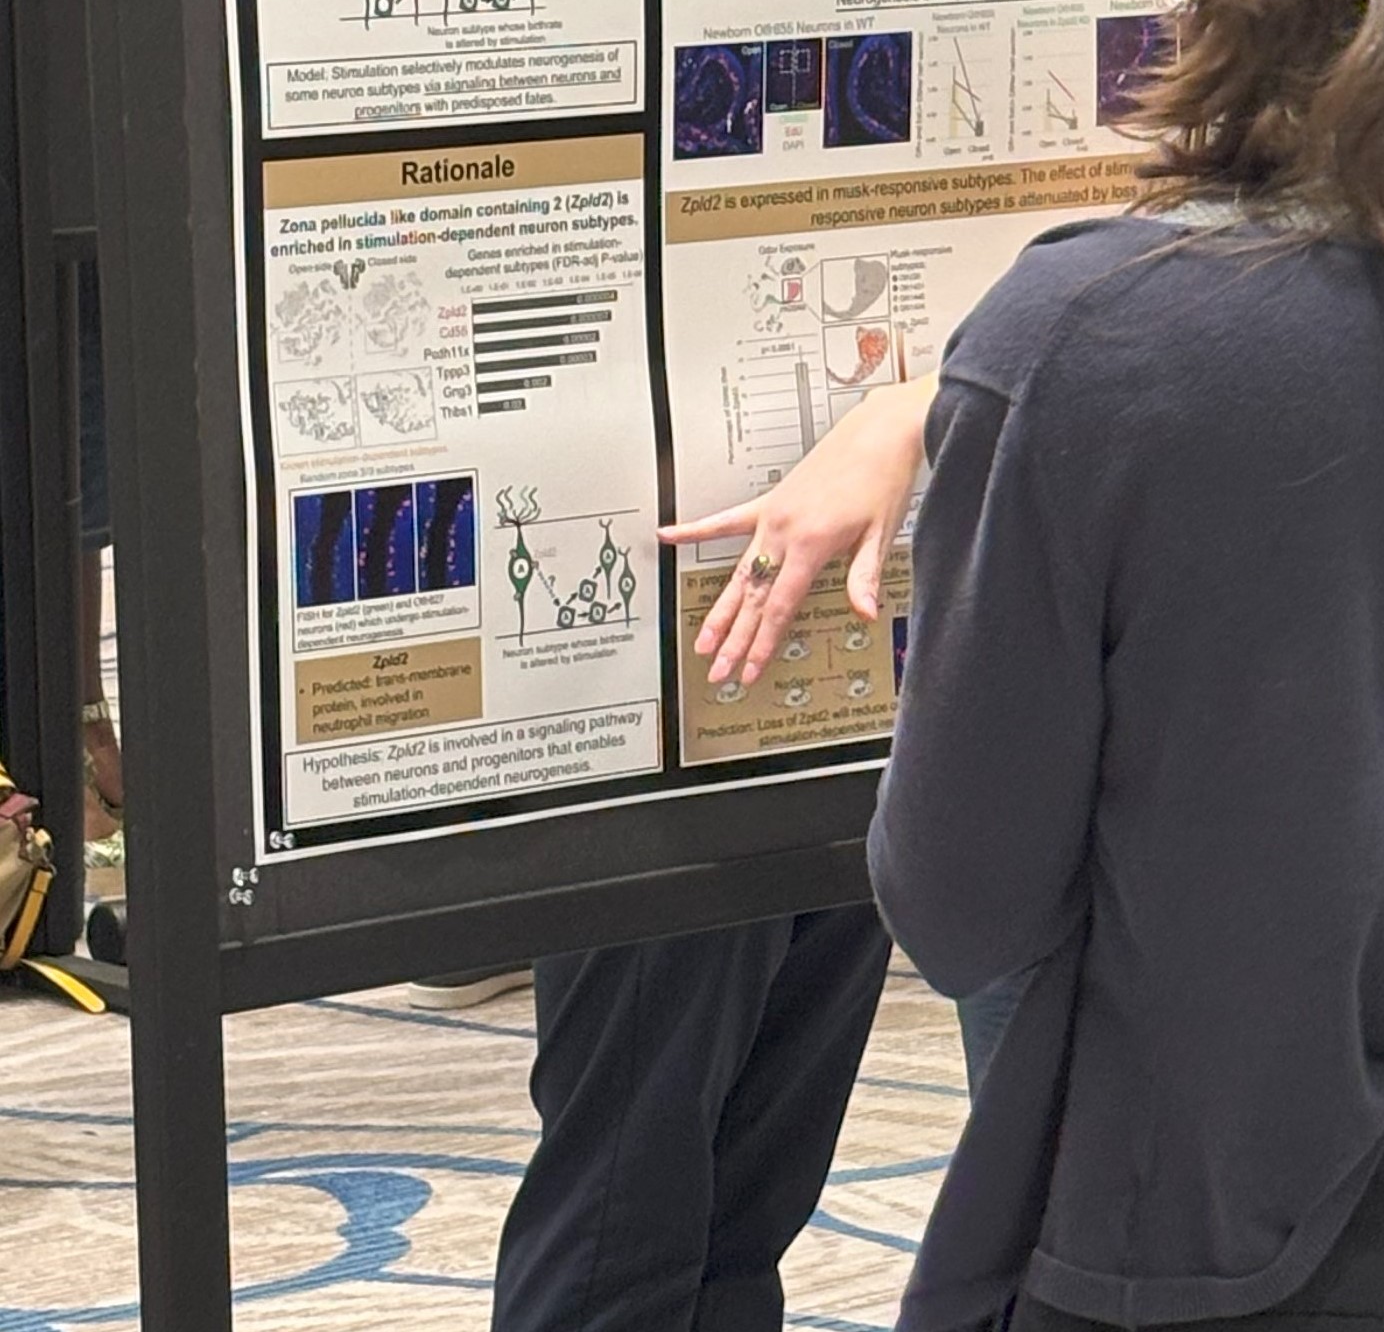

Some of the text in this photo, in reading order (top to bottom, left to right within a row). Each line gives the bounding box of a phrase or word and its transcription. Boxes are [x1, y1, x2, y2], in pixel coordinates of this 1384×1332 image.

[401, 154, 515, 186] Rationale
[279, 190, 630, 235] Zona pellucida like domain containing 2 (Zpld2) is
[269, 214, 639, 258] enriched in stimulation-dependent neuron subtypes.
[386, 740, 426, 763] Zpld2
[428, 739, 441, 754] is
[443, 728, 498, 752] involved
[500, 727, 514, 743] in
[516, 728, 526, 741] a
[527, 718, 586, 741] signaling
[588, 711, 643, 733] pathway
[321, 734, 627, 792] between neurons and progenitors that enables
[352, 772, 501, 809] stimulation-dependent
